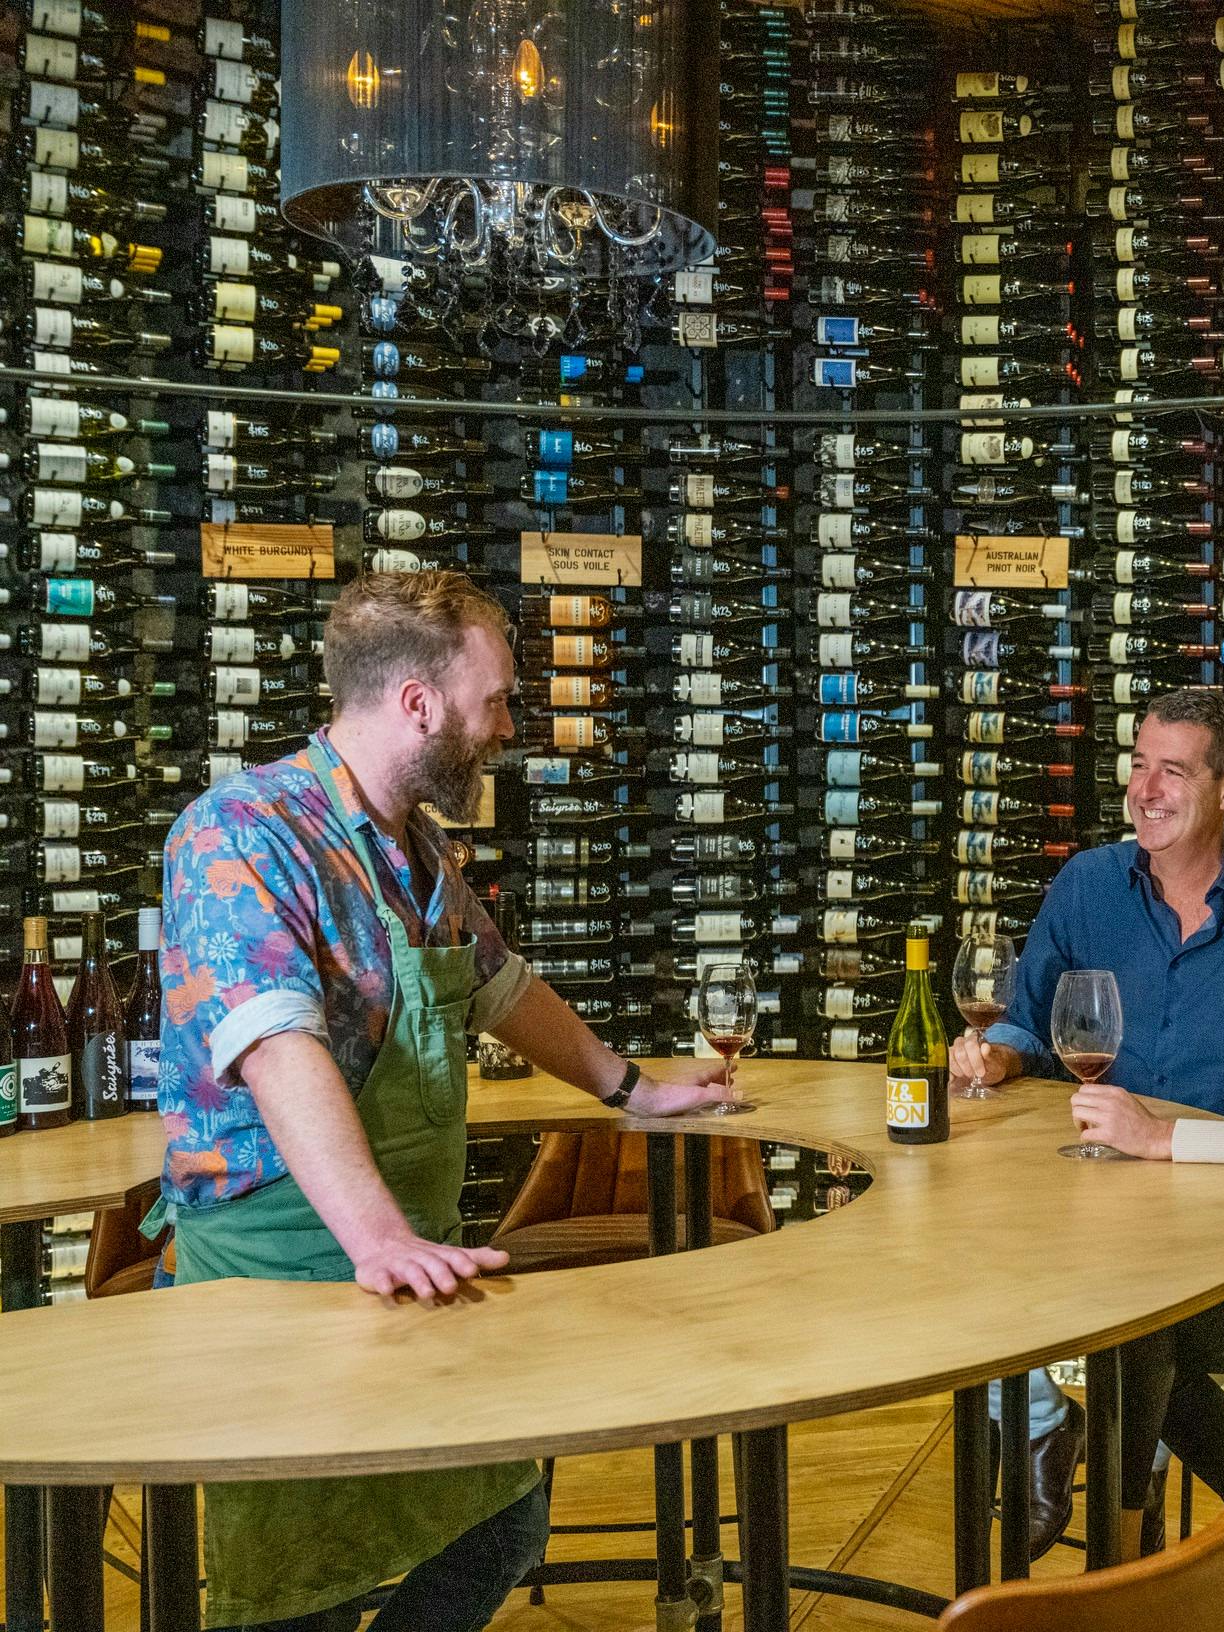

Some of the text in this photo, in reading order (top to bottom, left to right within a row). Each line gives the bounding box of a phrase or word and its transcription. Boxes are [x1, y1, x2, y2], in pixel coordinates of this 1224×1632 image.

[223, 544, 313, 556] WHITE BURGUNDY
[548, 547, 615, 559] SKIN CONTACT
[986, 551, 1039, 561] AUSTRALIAN
[553, 560, 610, 571] SOUS VOILE
[987, 563, 1036, 573] PINOT NOIR
